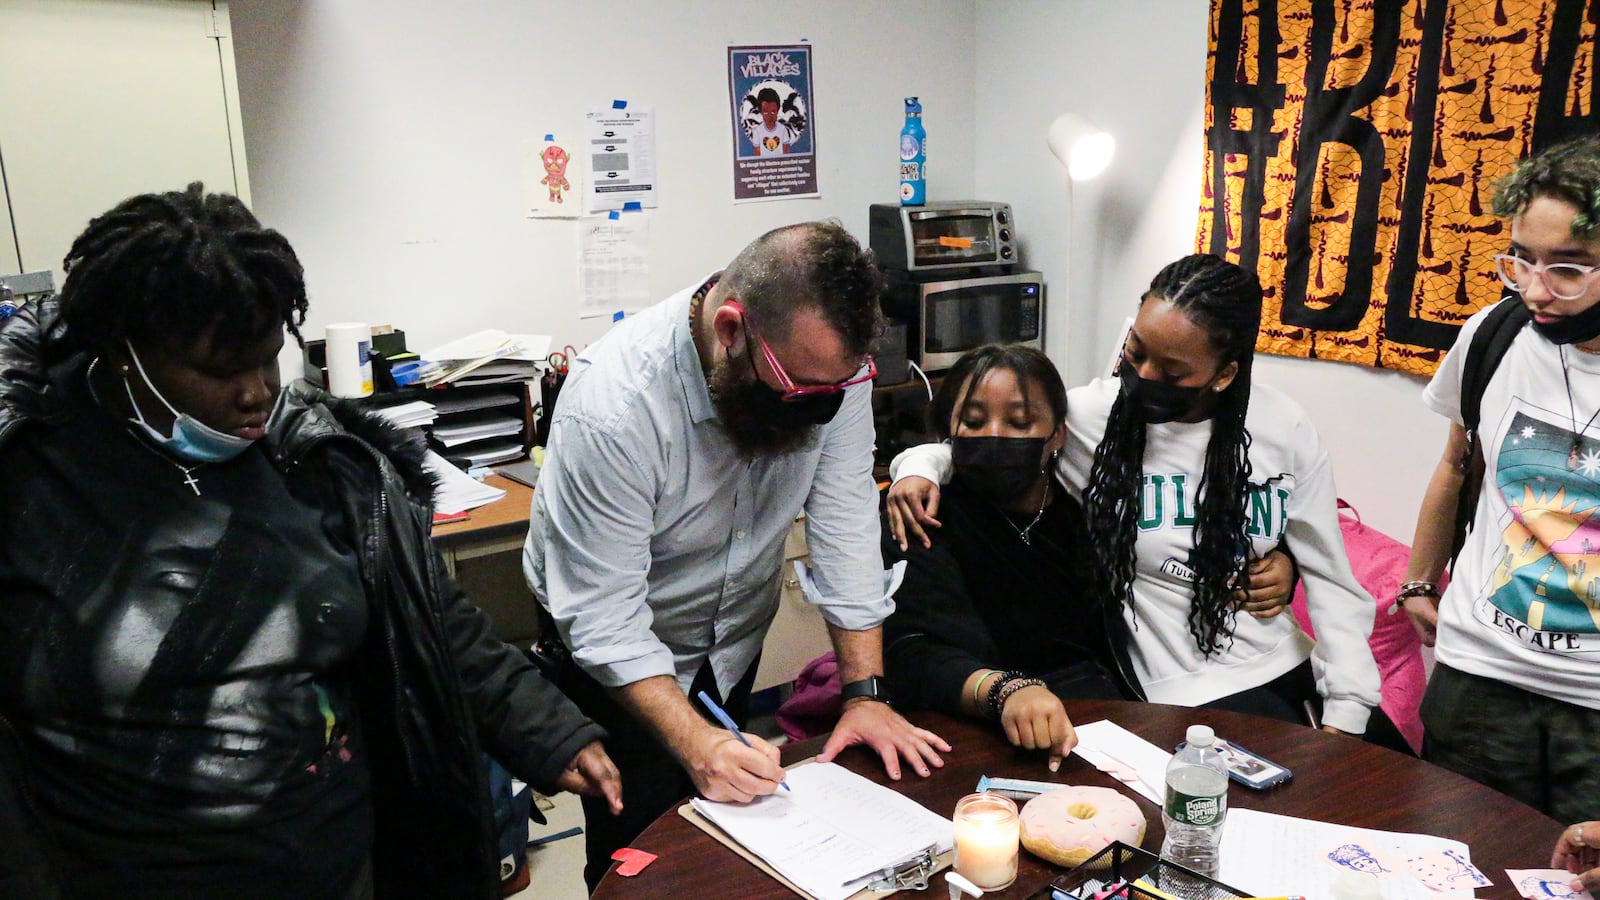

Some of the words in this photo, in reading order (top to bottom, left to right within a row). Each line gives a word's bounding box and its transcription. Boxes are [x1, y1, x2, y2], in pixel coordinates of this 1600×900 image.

[748, 51, 792, 65] BLACK
[740, 62, 801, 78] VILLAGES
[1137, 474, 1289, 541] ULN
[1171, 564, 1197, 580] TULA
[1493, 609, 1580, 650] ESCAPE
[1186, 798, 1217, 810] Poland
[1187, 808, 1217, 820] Spring
